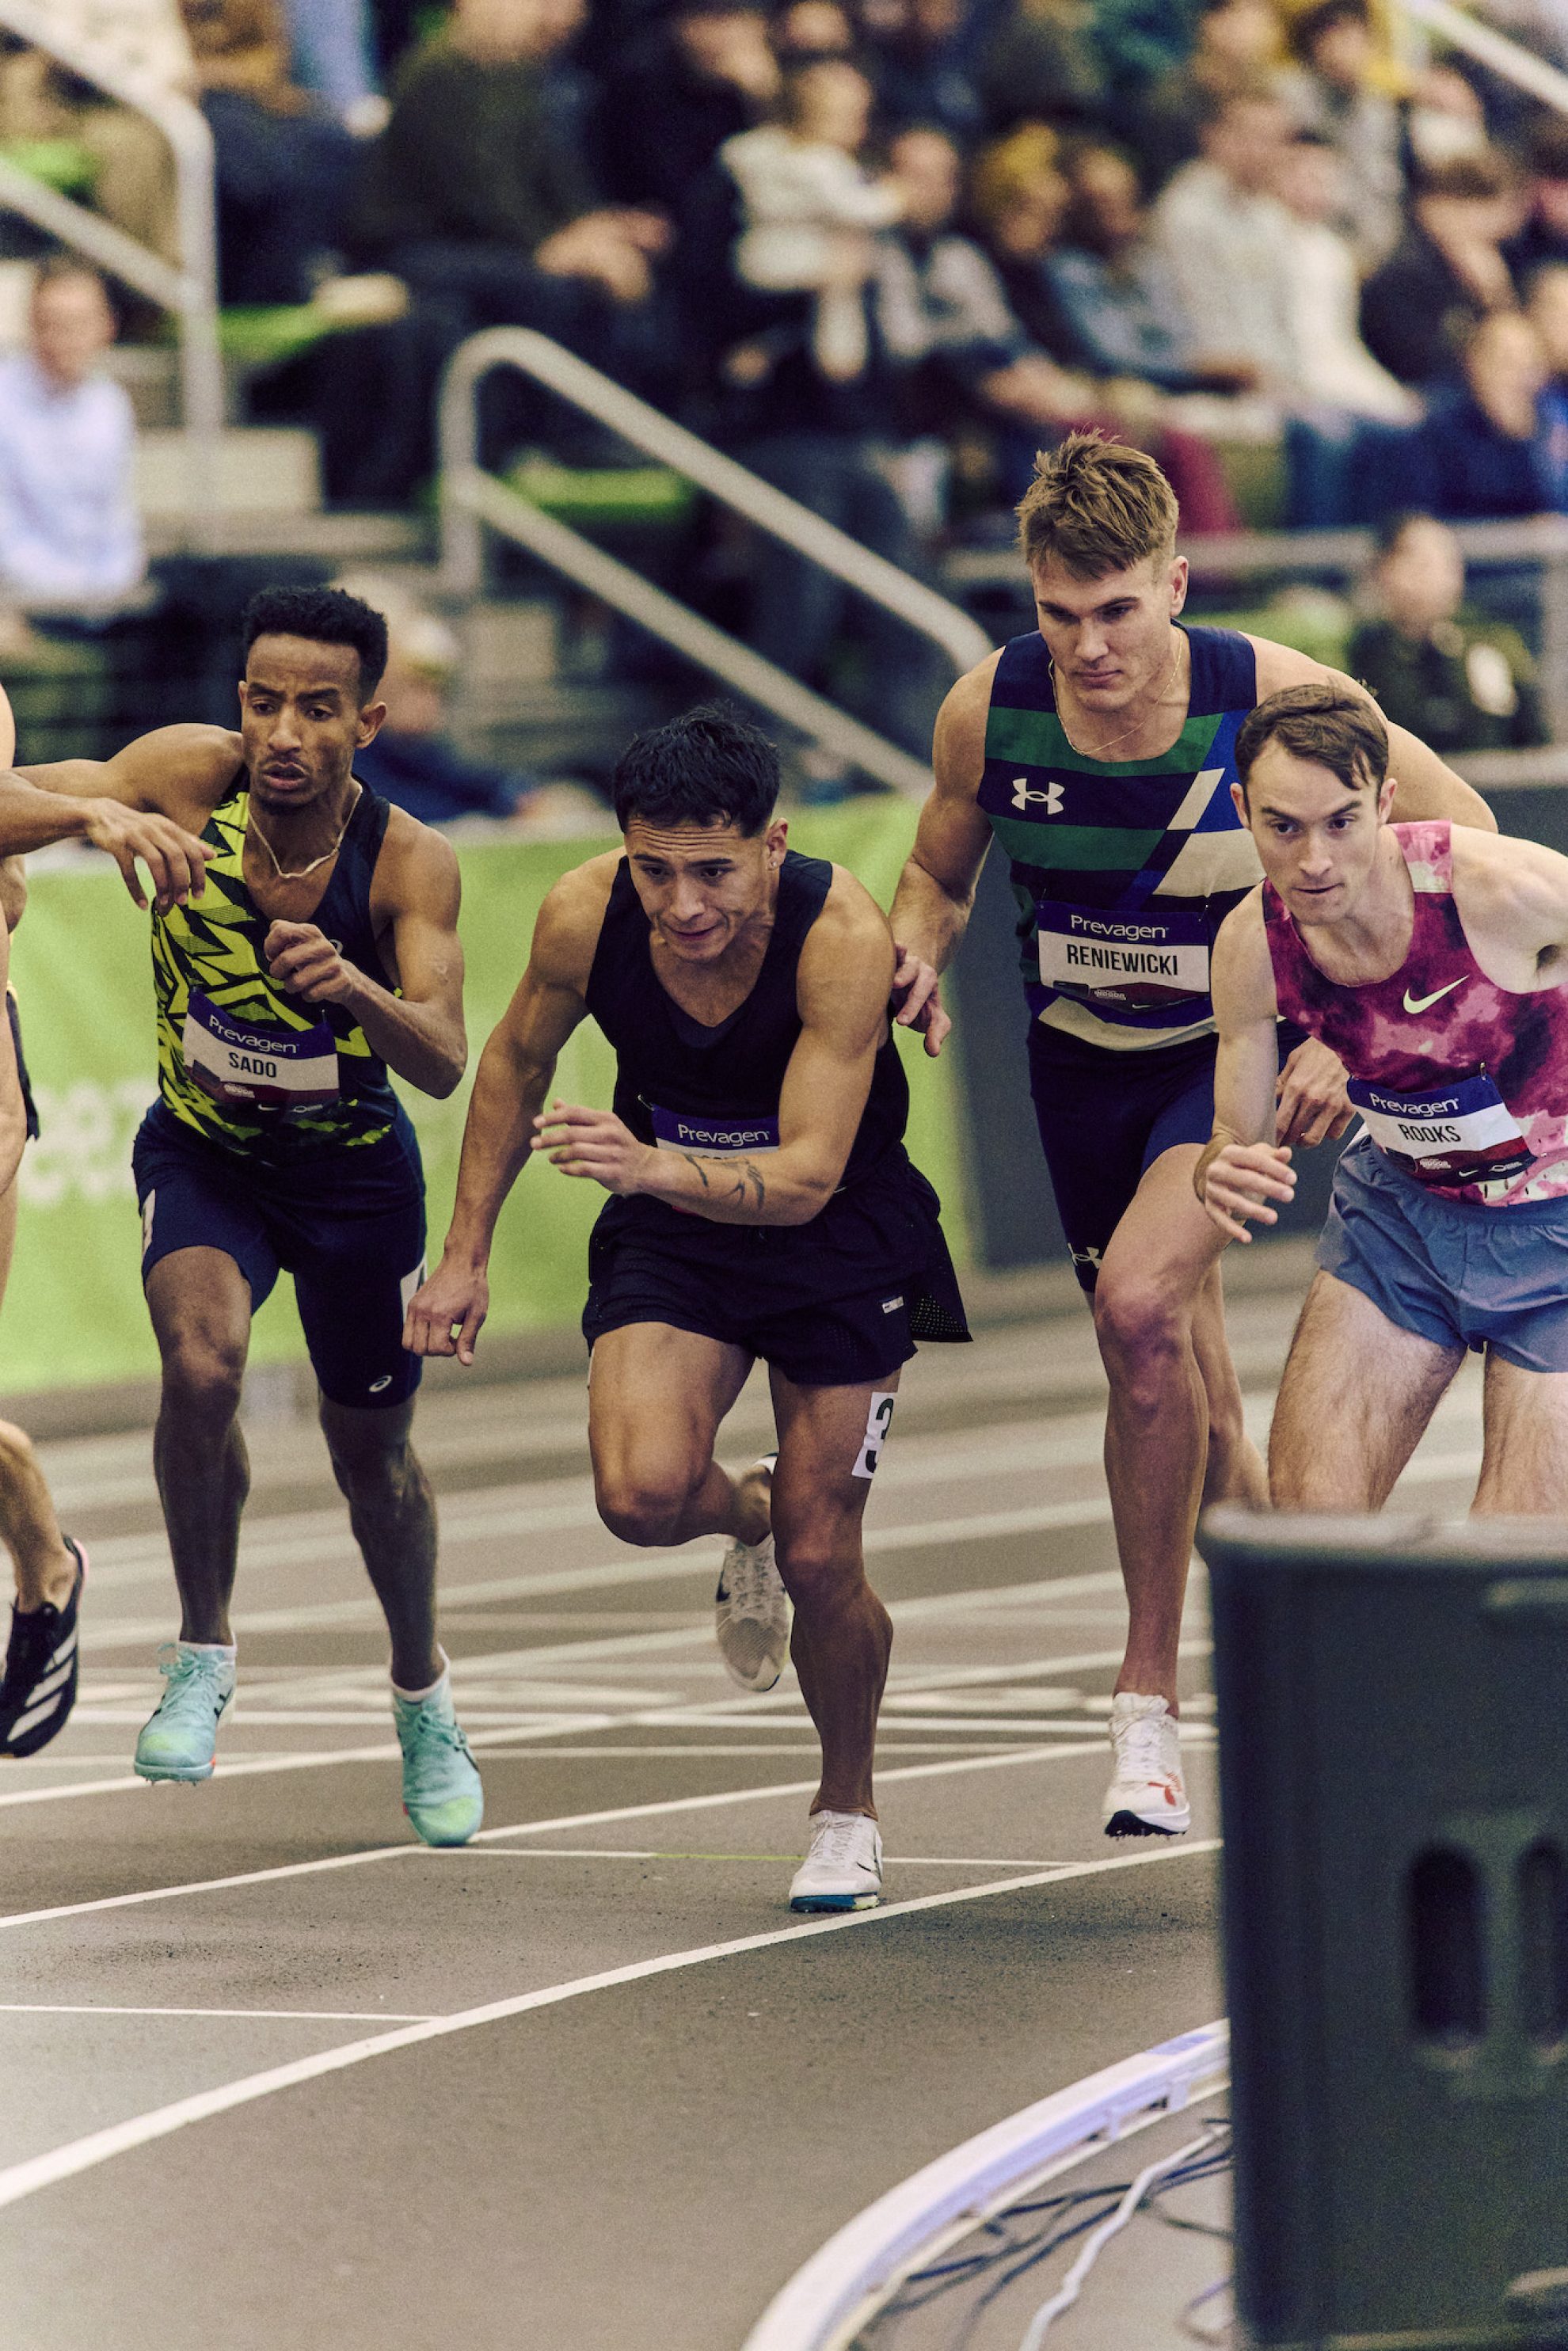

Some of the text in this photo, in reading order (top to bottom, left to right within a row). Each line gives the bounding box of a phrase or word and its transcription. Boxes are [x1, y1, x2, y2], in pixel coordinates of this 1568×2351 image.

[1070, 914, 1166, 941] Prevagen
[1066, 943, 1178, 976] RENIEWICKI
[208, 1014, 298, 1054] Prevagen
[228, 1051, 278, 1078] SADO
[1368, 1092, 1460, 1117] Prevagen
[677, 1123, 770, 1147] Prevagen
[1397, 1122, 1462, 1143] ROOKS
